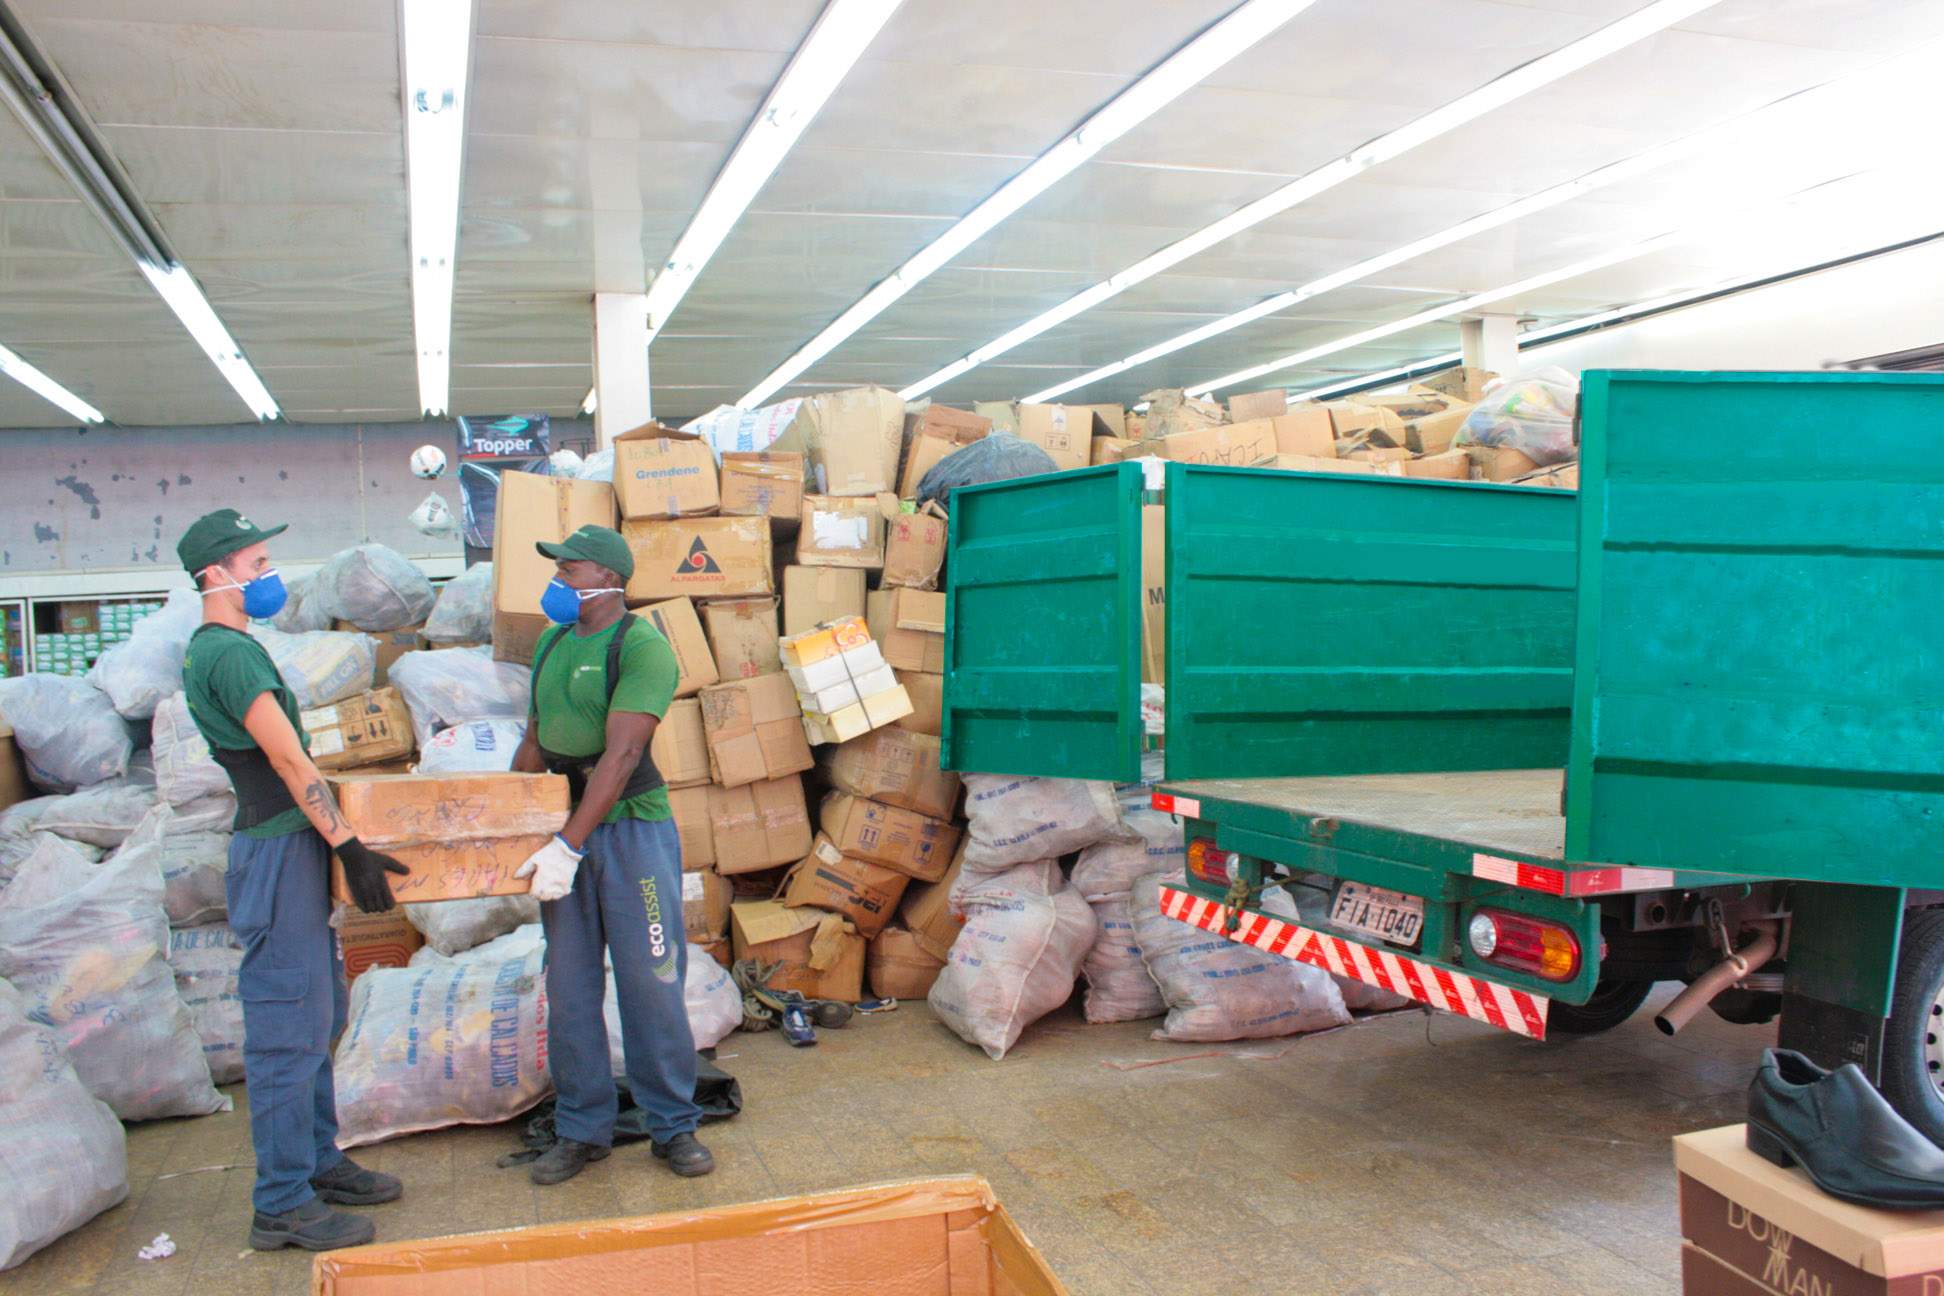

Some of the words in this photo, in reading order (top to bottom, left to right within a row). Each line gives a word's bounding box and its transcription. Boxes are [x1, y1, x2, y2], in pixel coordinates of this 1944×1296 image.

[473, 437, 533, 455] Topper
[635, 466, 700, 480] Grendene
[670, 574, 726, 583] ALPARGATAS
[638, 875, 666, 957] ecoassist
[1728, 1200, 1795, 1254] DOW
